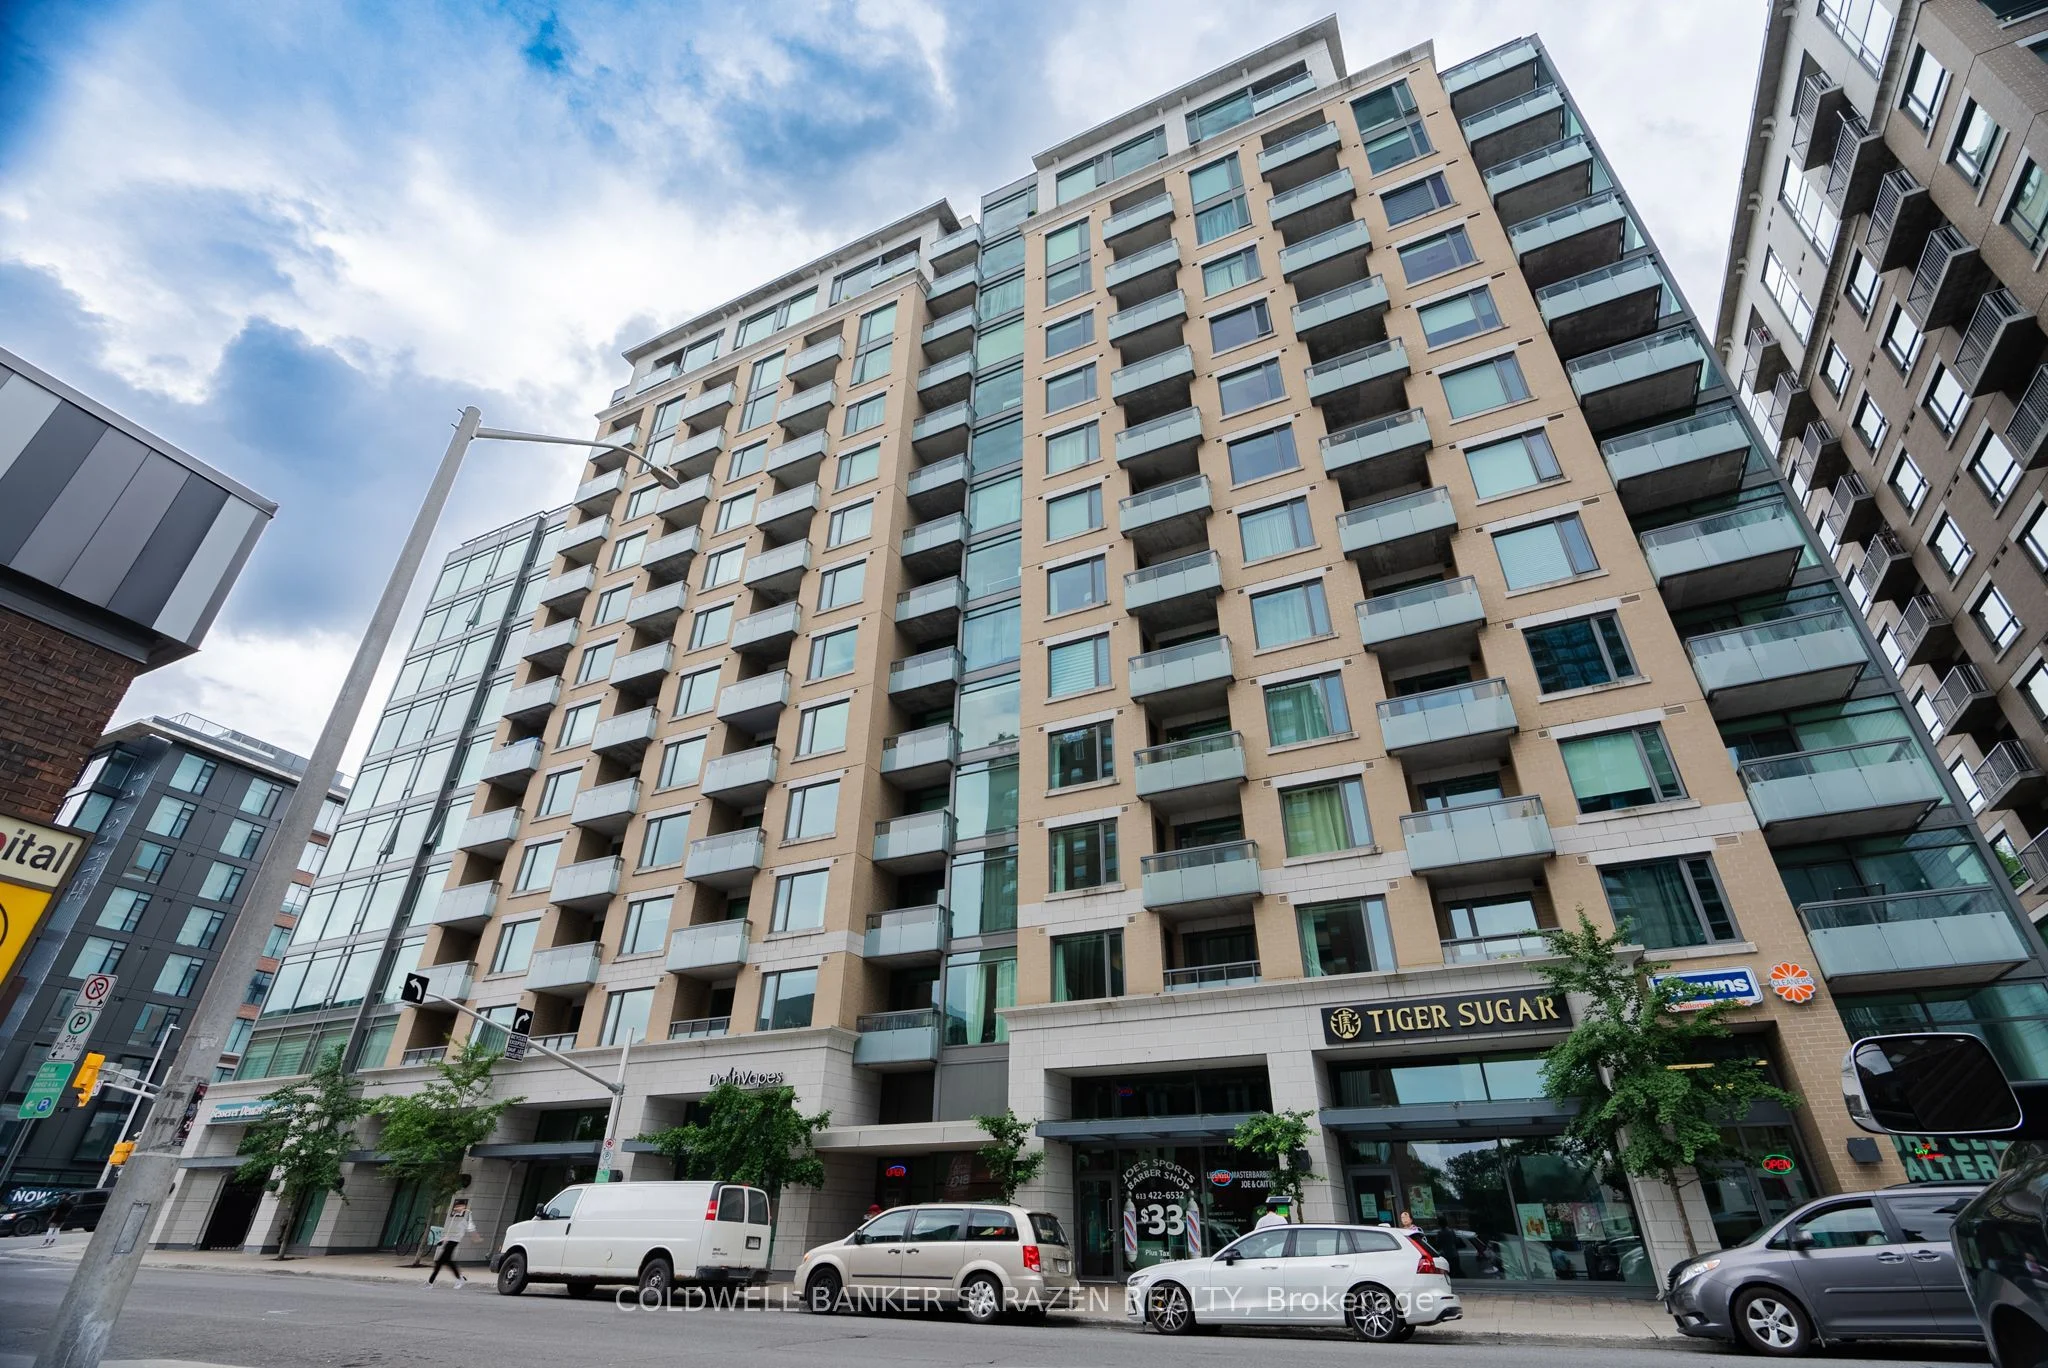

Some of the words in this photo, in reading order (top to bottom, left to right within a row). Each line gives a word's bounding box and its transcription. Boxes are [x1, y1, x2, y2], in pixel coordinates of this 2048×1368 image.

[1772, 977, 1813, 987] CLEANERS
[1367, 1005, 1451, 1033] TIGER
[1458, 997, 1560, 1027] SUGAR
[1763, 1159, 1791, 1170] OPEN
[1122, 1160, 1148, 1184] JOE'S
[1152, 1158, 1195, 1184] SPORTS
[1127, 1168, 1161, 1190] BARBER
[1164, 1171, 1190, 1190] SHOP
[1240, 1180, 1251, 1189] JOE
[1148, 1191, 1185, 1200] 422-6532
[1140, 1203, 1185, 1236] $33
[1145, 1248, 1158, 1256] Plus
[1159, 1249, 1170, 1257] Tax
